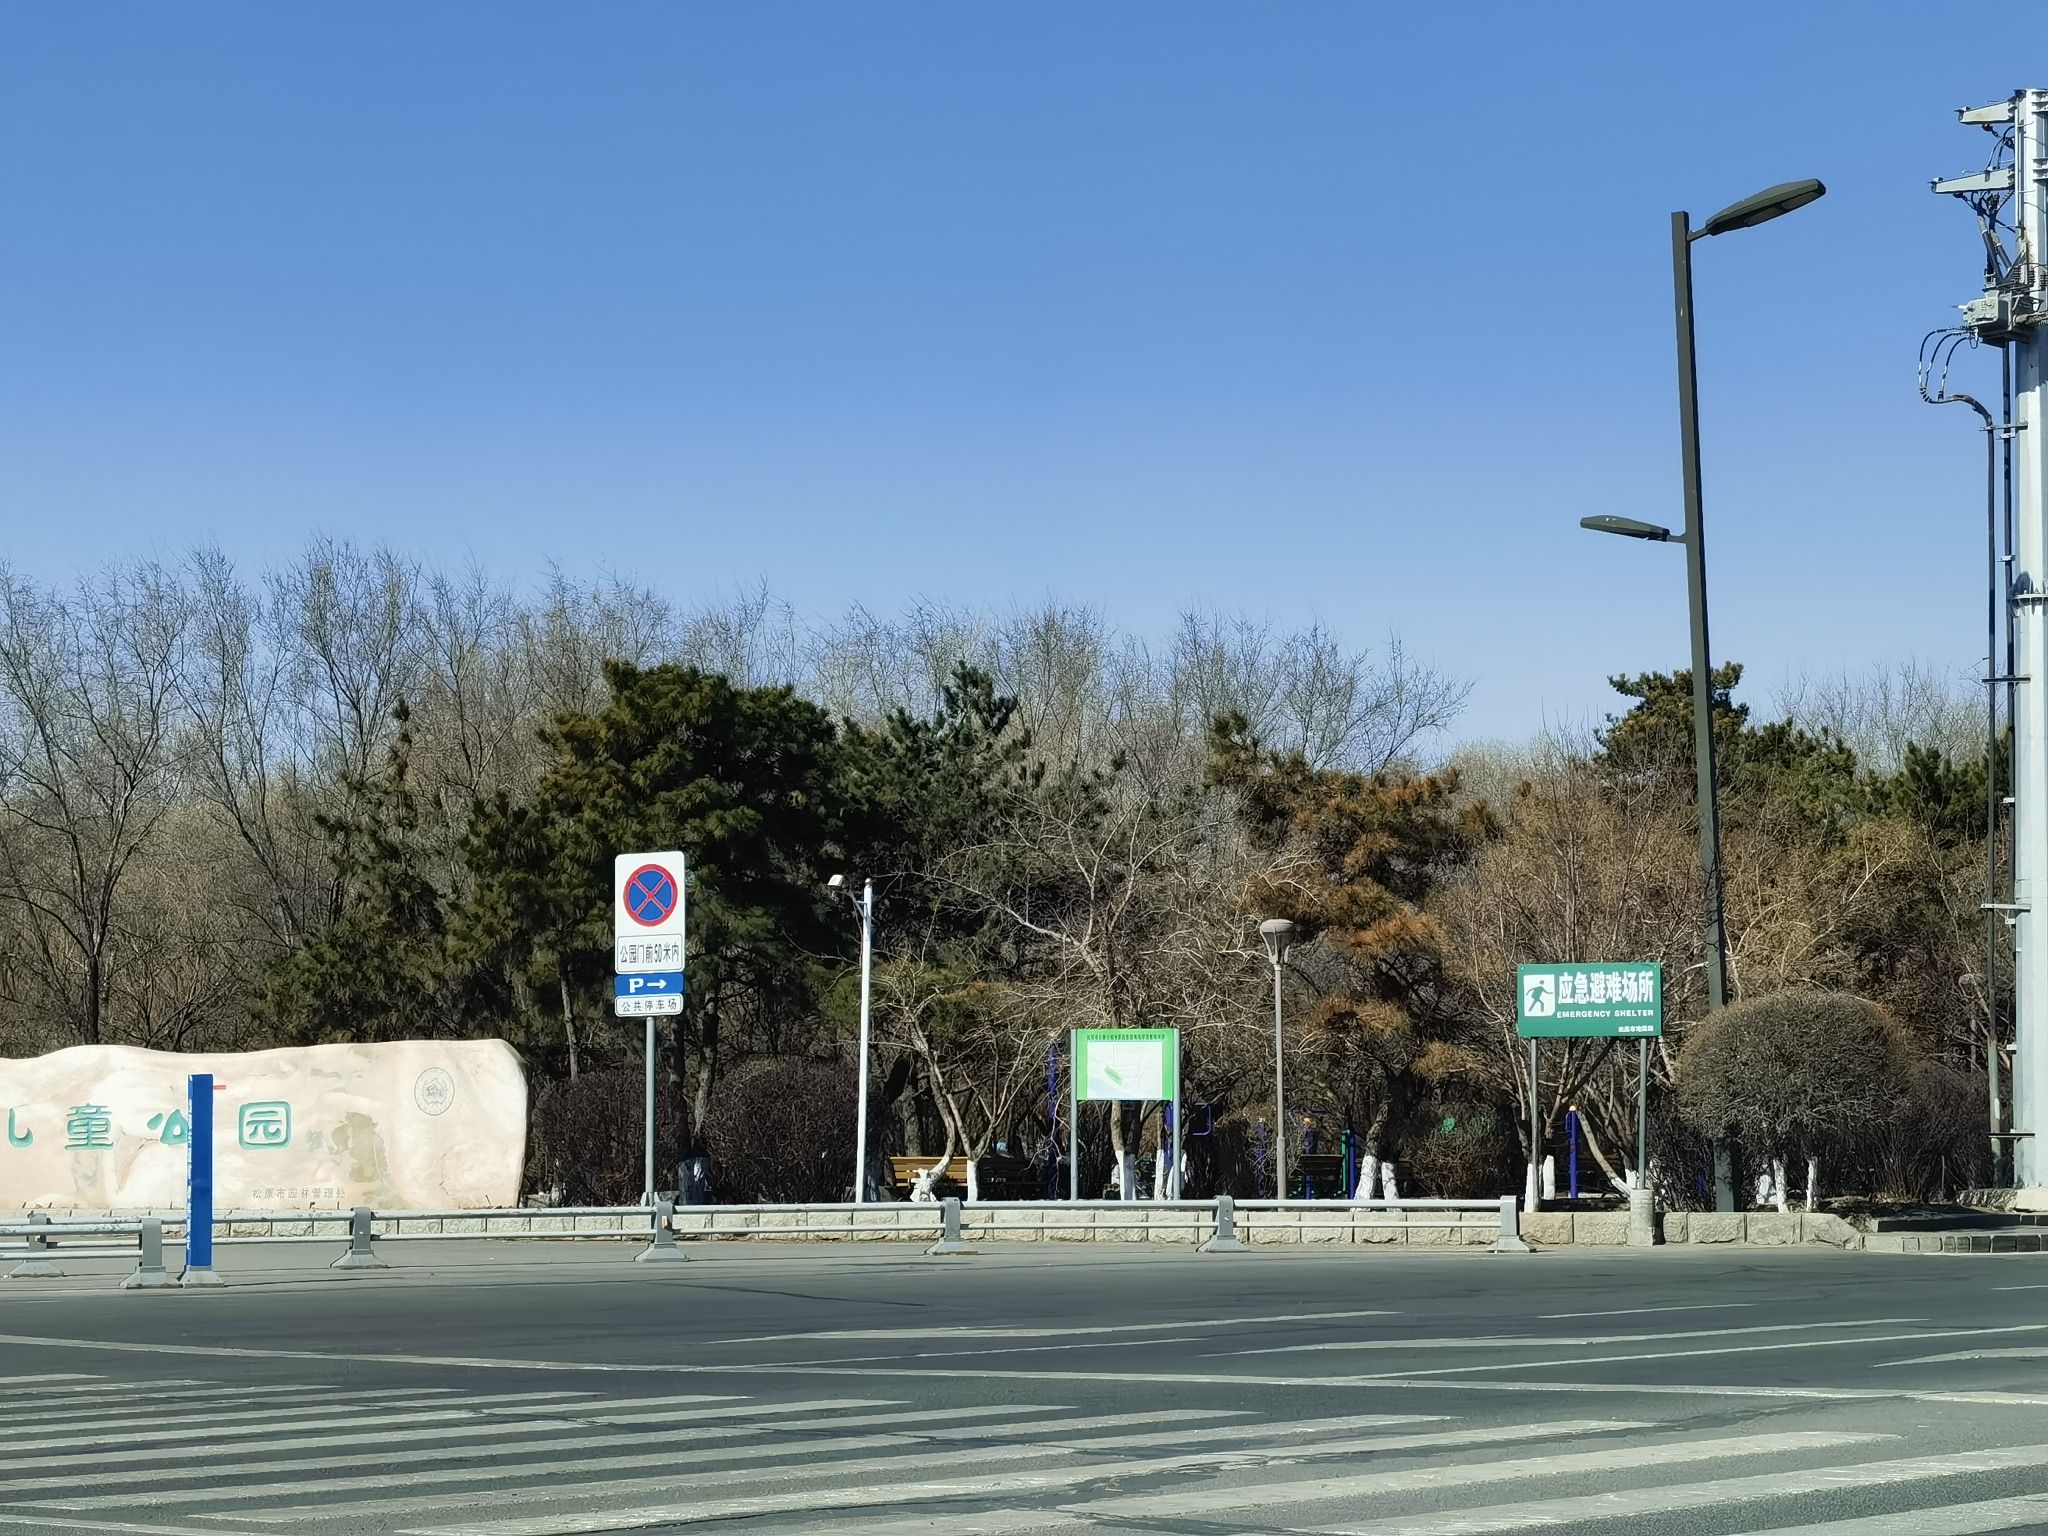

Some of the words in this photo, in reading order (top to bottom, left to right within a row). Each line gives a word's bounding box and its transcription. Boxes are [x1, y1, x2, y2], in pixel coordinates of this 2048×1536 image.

[620, 943, 679, 963] 公园门前50米内
[629, 978, 644, 993] P
[1558, 971, 1654, 1004] 应急避难场所
[621, 998, 677, 1012] 公共停车场
[1556, 1010, 1611, 1018] EMERGENCY
[1614, 1009, 1654, 1017] SHELTER
